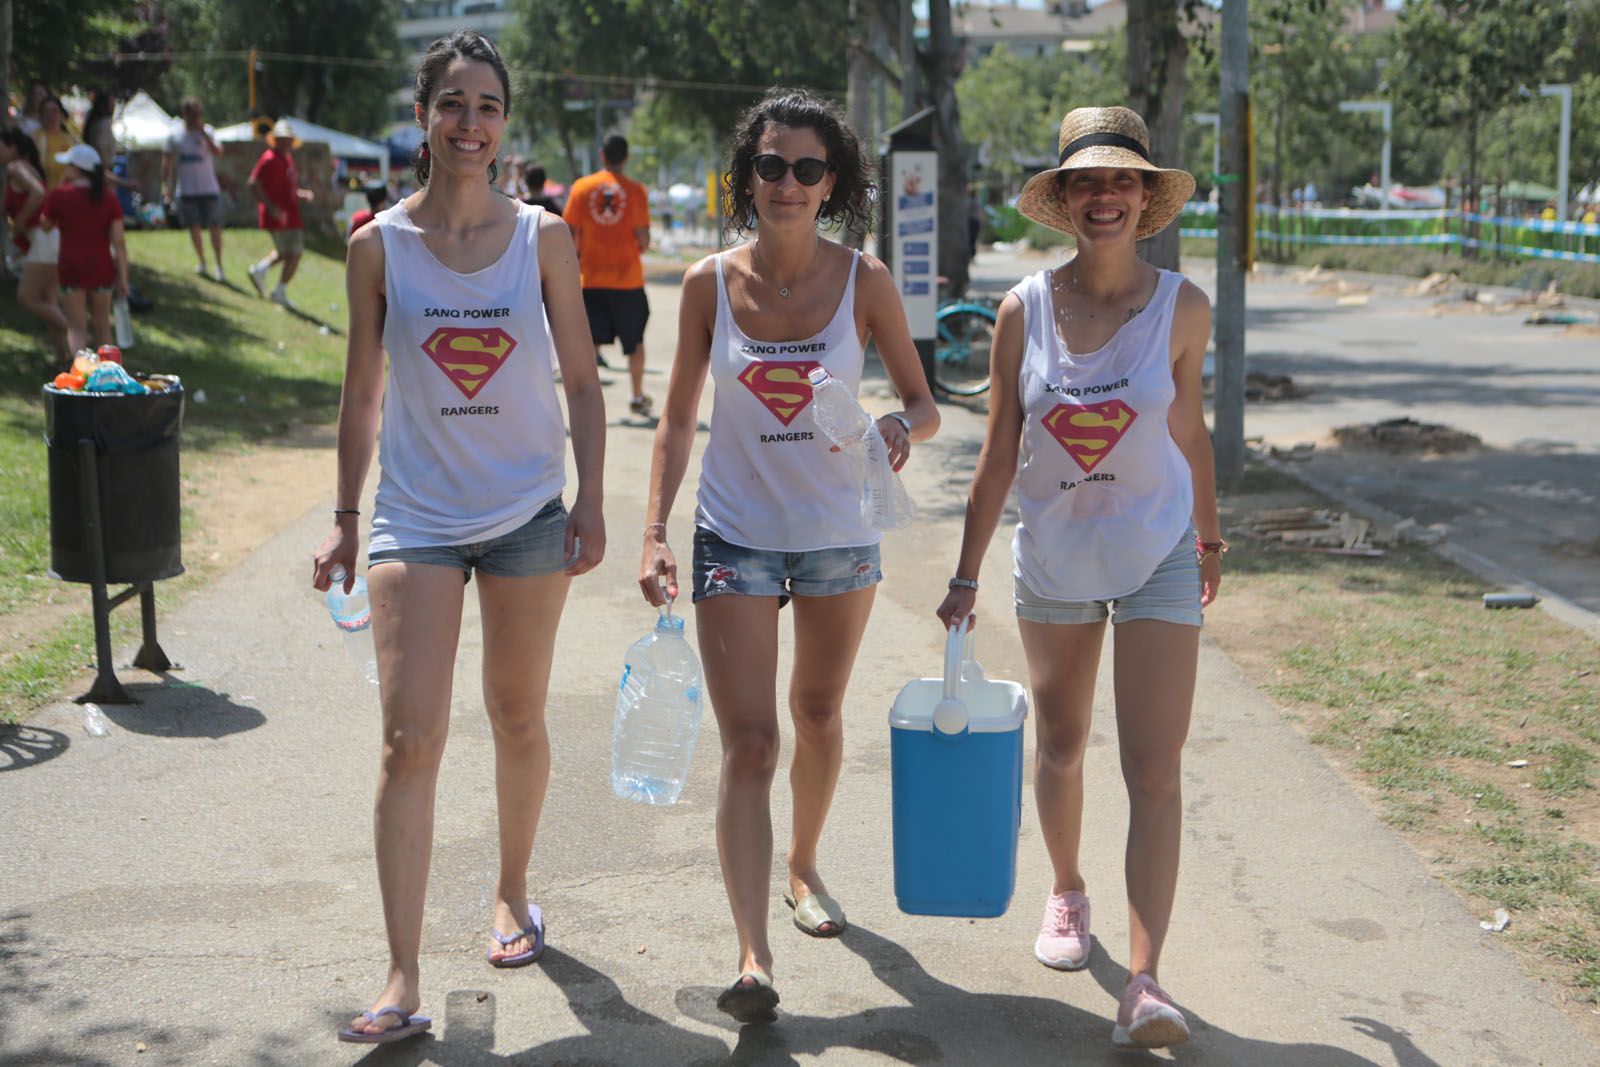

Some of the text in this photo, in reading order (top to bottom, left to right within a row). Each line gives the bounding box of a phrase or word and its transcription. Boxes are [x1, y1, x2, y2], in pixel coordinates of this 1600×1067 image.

[424, 308, 510, 318] SANQ POWER
[779, 343, 826, 354] POWER
[1083, 378, 1129, 396] POWER
[441, 406, 500, 416] RANGERS
[760, 432, 814, 443] RANGERS
